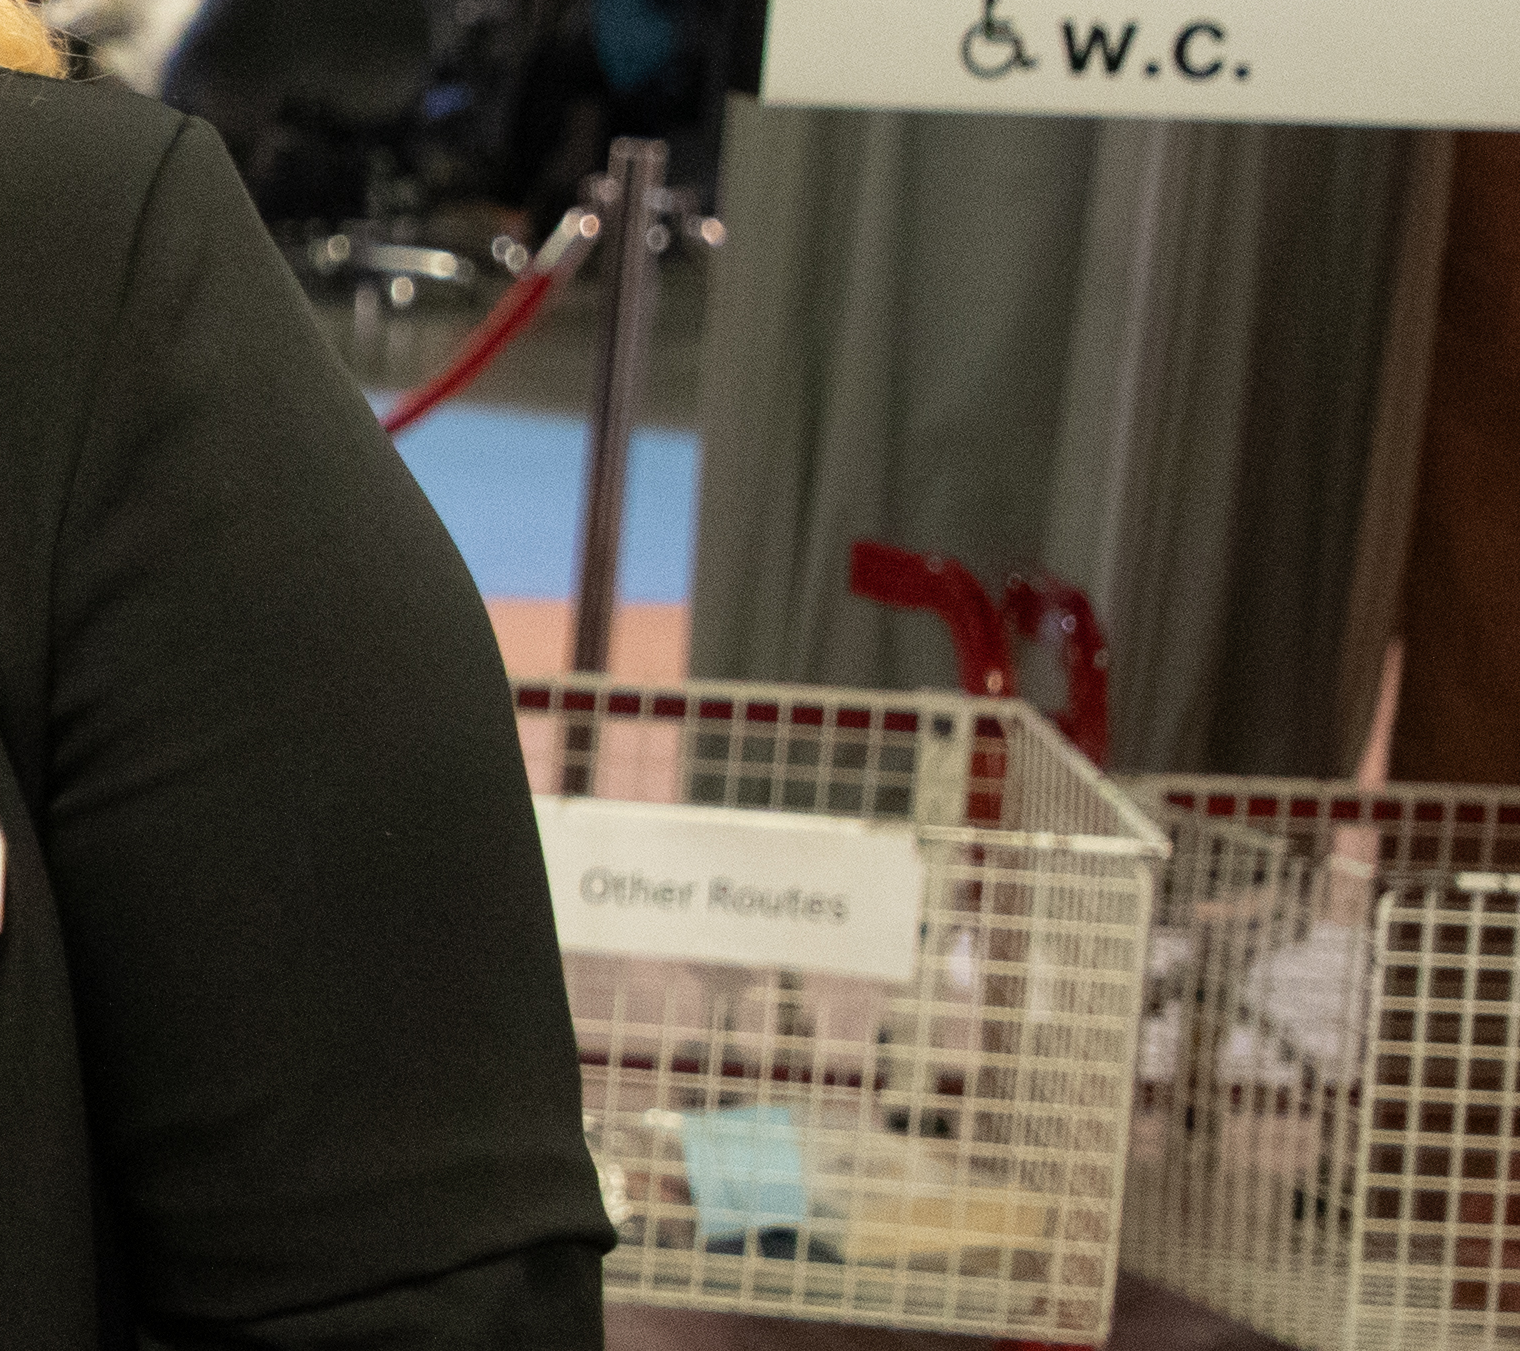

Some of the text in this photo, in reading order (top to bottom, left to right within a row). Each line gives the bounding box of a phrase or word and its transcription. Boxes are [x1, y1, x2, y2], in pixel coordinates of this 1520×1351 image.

[1060, 19, 1251, 81] W.C.
[579, 866, 850, 925] Other Routes
